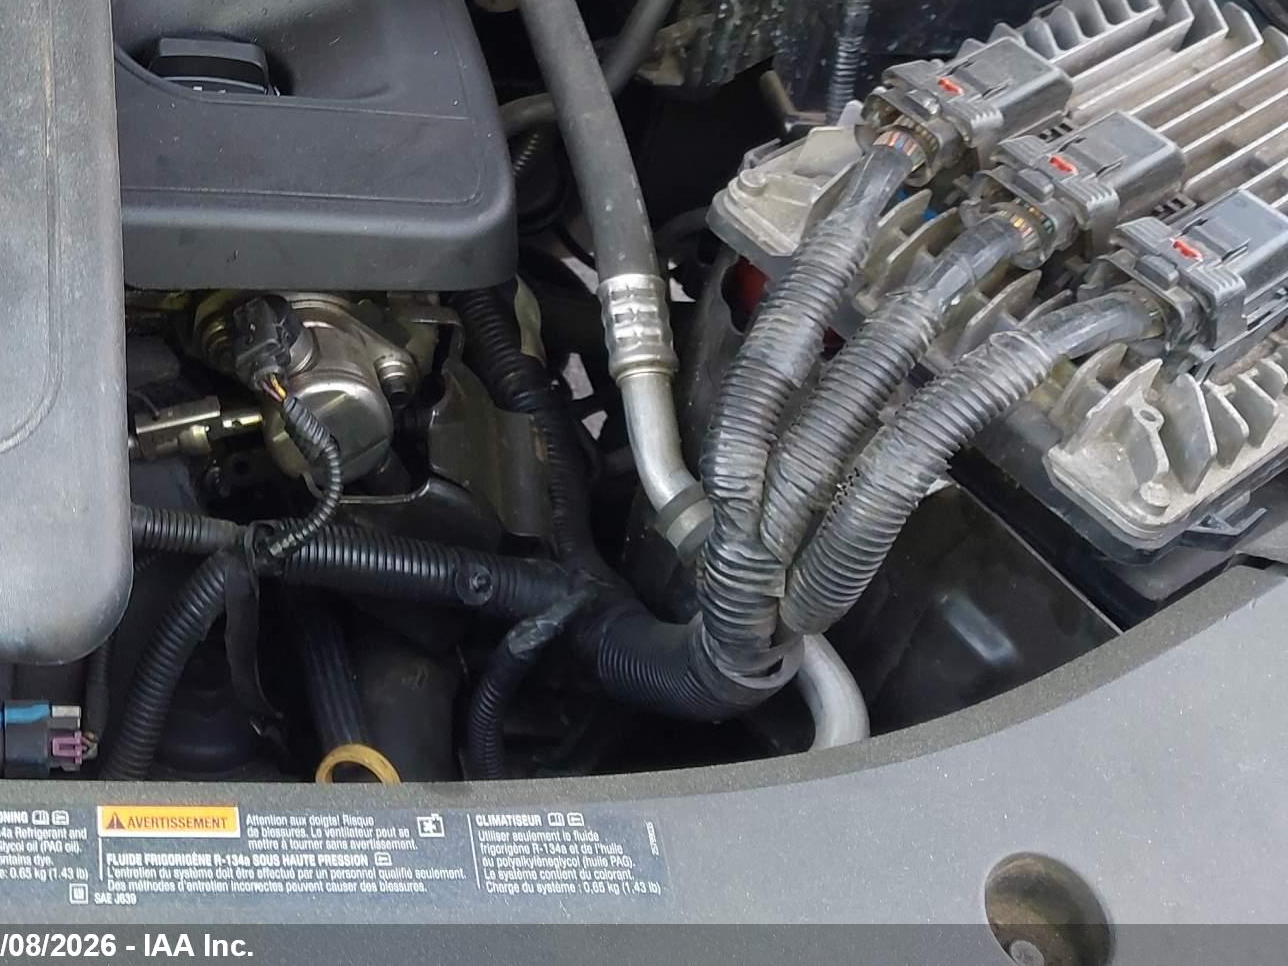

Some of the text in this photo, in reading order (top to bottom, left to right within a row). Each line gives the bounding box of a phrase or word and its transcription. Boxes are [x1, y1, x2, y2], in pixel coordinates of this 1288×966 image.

[128, 817, 227, 828] AVERTISSEMENT
[476, 815, 542, 826] CLIMATISEUR
[15, 828, 66, 840] Refrigerant
[69, 828, 86, 838] and
[34, 855, 53, 867] dye.
[282, 855, 315, 866] HAUTE
[318, 854, 368, 866] PRESSION
[94, 893, 112, 904] SAE
[114, 893, 136, 905] J639
